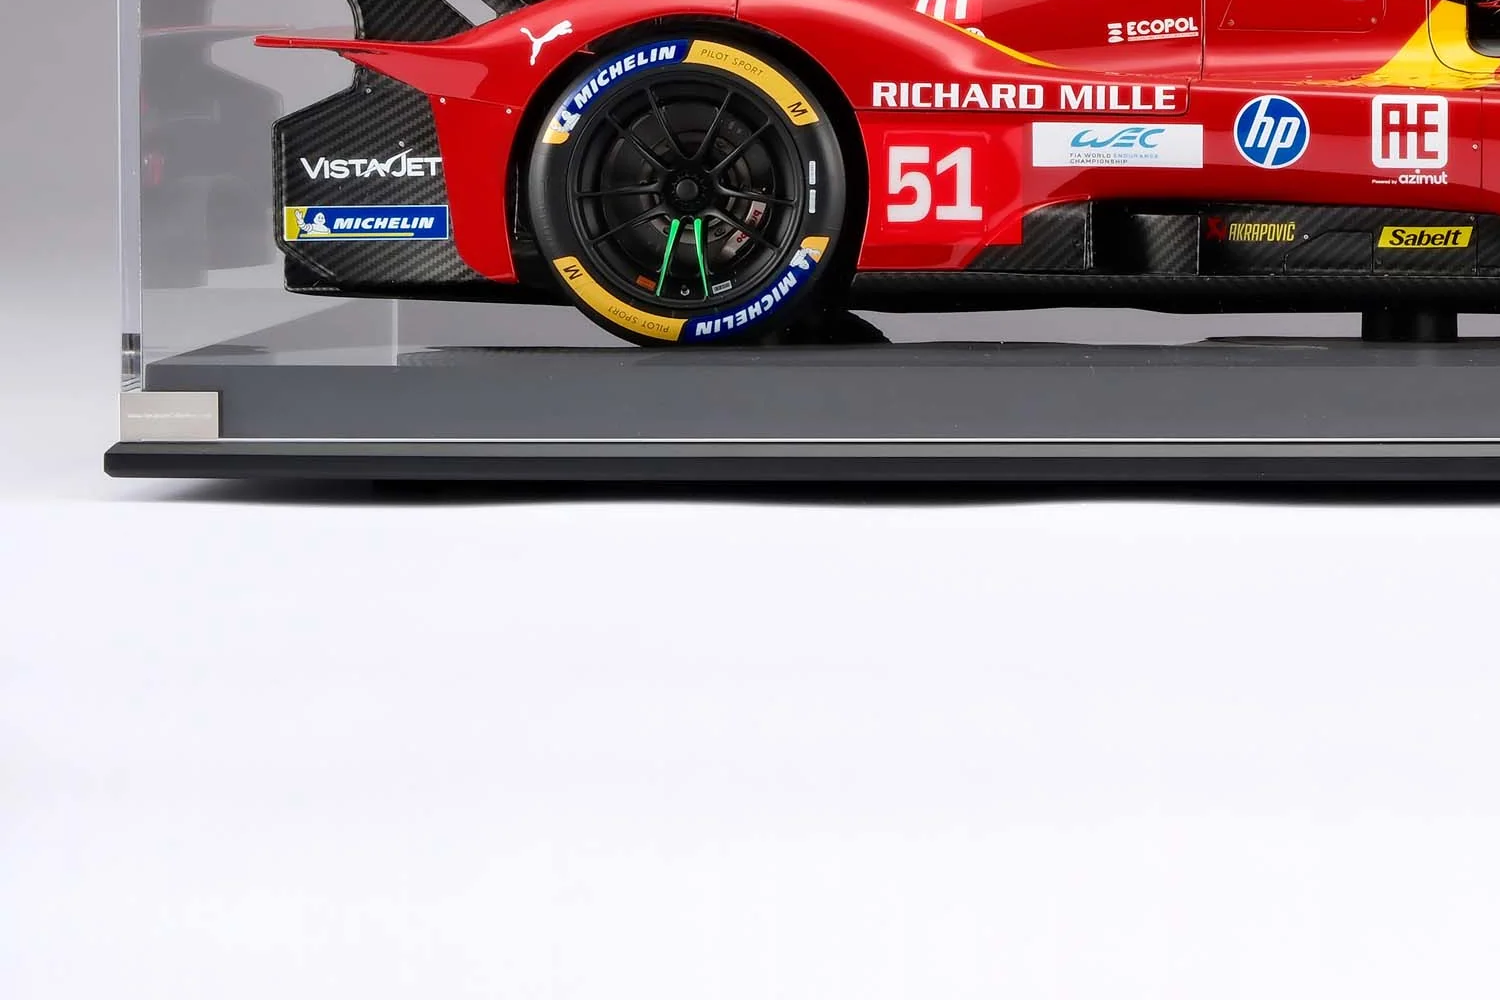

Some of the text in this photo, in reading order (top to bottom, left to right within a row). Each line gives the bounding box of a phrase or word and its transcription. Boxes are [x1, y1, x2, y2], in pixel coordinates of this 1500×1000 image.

[1126, 17, 1199, 36] ECOPOL
[700, 48, 764, 76] PILOT SPORT
[574, 43, 677, 109] MICHELIN
[872, 81, 1176, 110] RICHARD MILLE
[786, 100, 808, 118] M
[1070, 126, 1166, 149] WEC
[1244, 97, 1300, 167] hp
[886, 145, 984, 223] 51
[1398, 168, 1448, 185] azimut
[333, 216, 435, 230] MICHELIN
[1388, 227, 1462, 247] Sabelt
[563, 263, 583, 281] M
[695, 270, 798, 337] MICHELIN
[607, 305, 670, 333] PILOT SPORT
